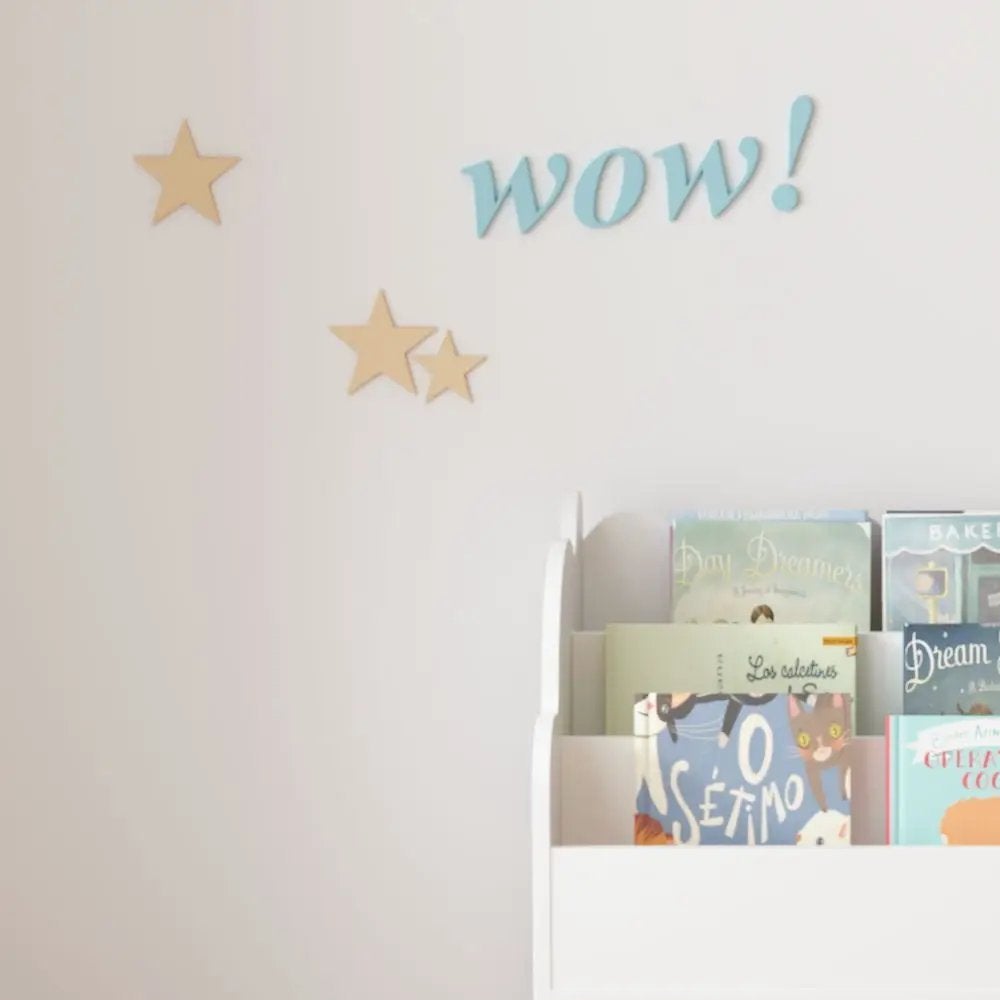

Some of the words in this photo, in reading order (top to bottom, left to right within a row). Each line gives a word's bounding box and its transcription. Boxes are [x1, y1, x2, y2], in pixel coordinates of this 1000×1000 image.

[461, 94, 815, 239] wow!
[674, 538, 731, 585] Day
[743, 530, 864, 592] Dreamers
[746, 653, 778, 683] Los
[780, 656, 839, 680] calcetines
[905, 631, 991, 693] Dream
[737, 713, 773, 785] O
